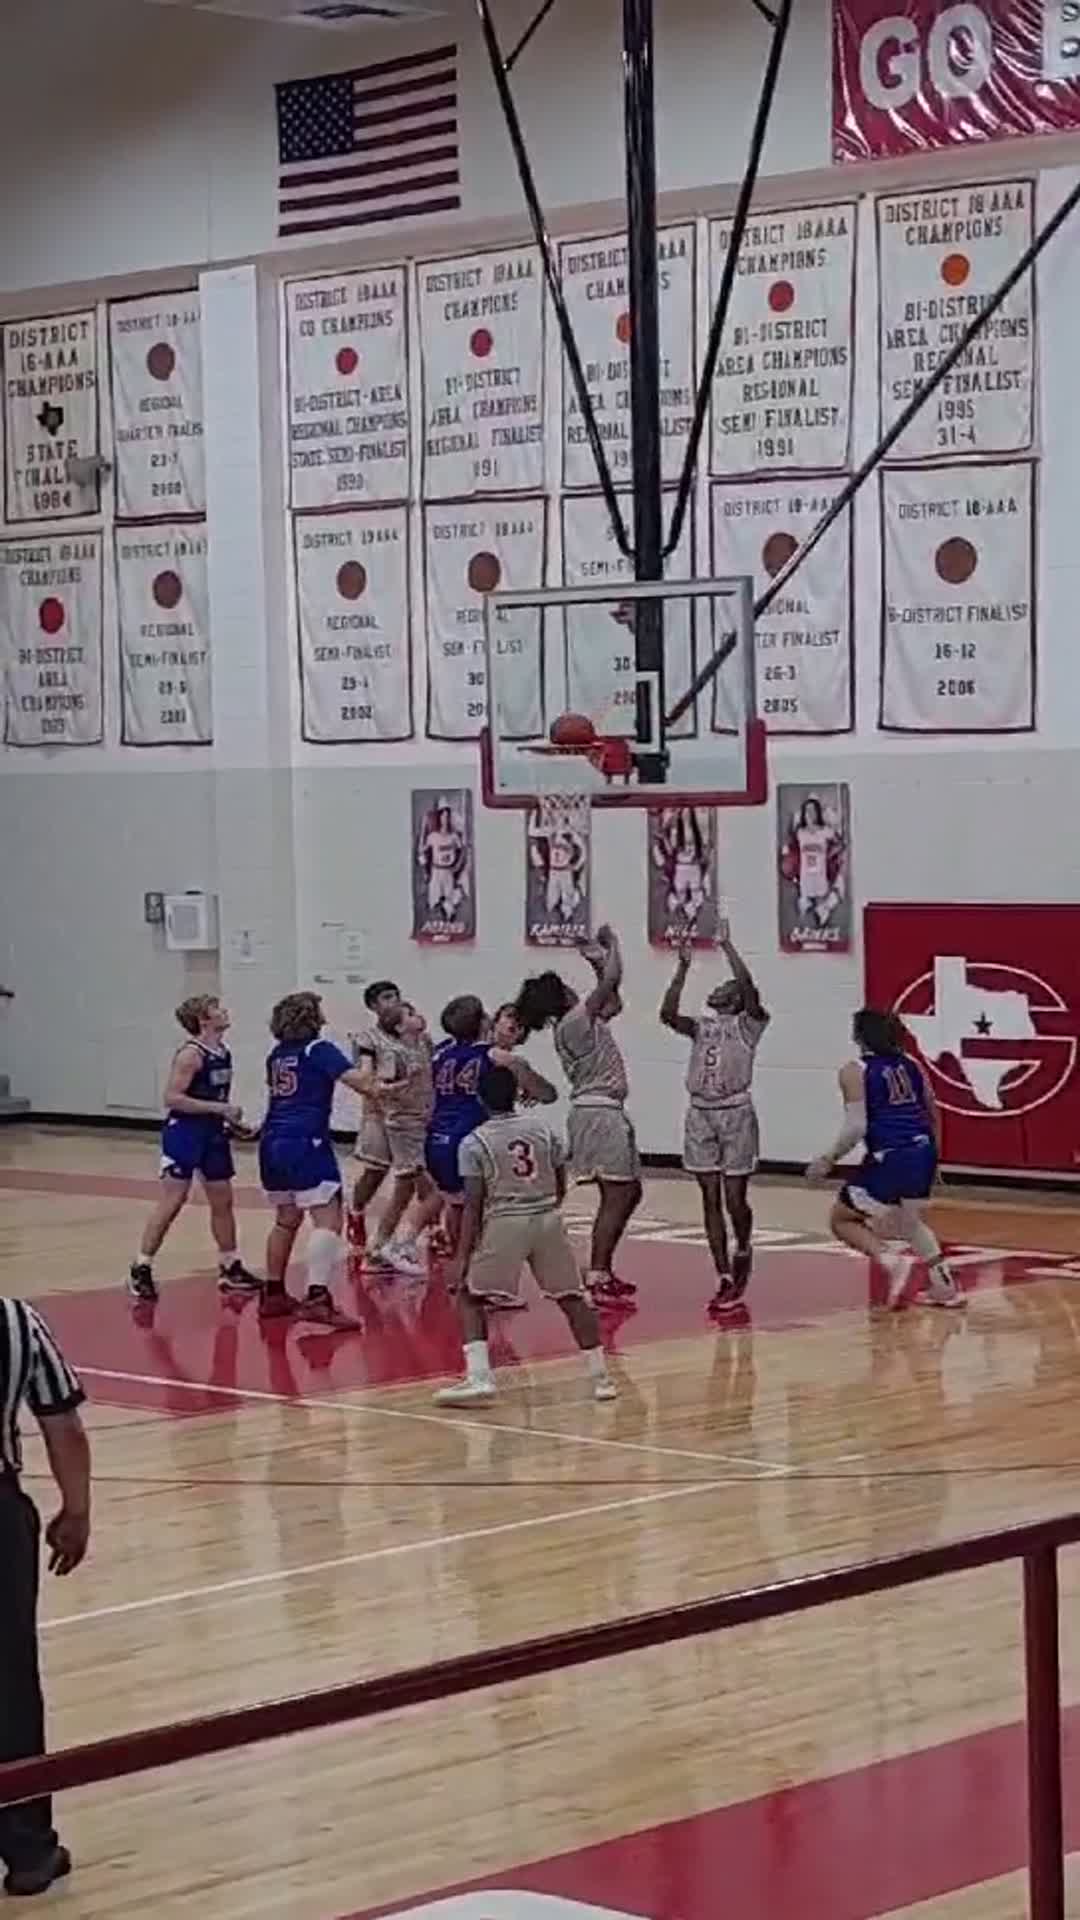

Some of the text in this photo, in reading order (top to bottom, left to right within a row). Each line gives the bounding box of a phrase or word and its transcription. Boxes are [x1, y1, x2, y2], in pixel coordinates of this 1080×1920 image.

[860, 3, 991, 110] GO
[885, 198, 959, 223] DISTRICT
[905, 216, 1003, 247] CHAMPIONS
[568, 248, 628, 275] DISTRICT
[738, 249, 827, 276] CHAMPIONS
[426, 268, 482, 293] DISTRICT
[295, 286, 347, 311] DISTRICT
[444, 291, 519, 321] CHAMPIONS
[9, 321, 88, 348] DISTRICT
[300, 310, 393, 337] CO CHAMPIONS
[734, 318, 827, 346] BI-DISTRICT
[886, 327, 928, 351] AREA
[716, 346, 847, 377] AREA CHAMPIONS
[8, 371, 95, 397] CHAMPIONS
[743, 378, 819, 402] REGIONAL
[943, 369, 1022, 396] FINALIST
[429, 394, 537, 427] AREA CHAMPIONS
[720, 407, 839, 435] SEMI FINALIST
[291, 412, 407, 441] REGIONAL CHAMPIONS
[937, 427, 976, 447] 31-4
[26, 440, 78, 463] STATE
[425, 424, 543, 457] REGIONAL FINALIST
[757, 437, 794, 456] 1991
[724, 500, 780, 517] DISTRICT
[899, 501, 960, 519] DISTRICT
[303, 530, 352, 549] DISTRICT
[433, 521, 485, 540] DISTRICT
[325, 615, 380, 631] REGIONAL
[966, 603, 1028, 621] FINALIST
[141, 623, 194, 638] REGIONAL
[782, 630, 841, 648] FINALIST
[935, 643, 977, 660] 16-12
[937, 680, 976, 696] 2006
[21, 695, 84, 712] CHAMPIONS
[704, 1045, 718, 1067] 5
[270, 1057, 298, 1097] 15
[434, 1059, 480, 1096] 44
[507, 1139, 536, 1178] 3
